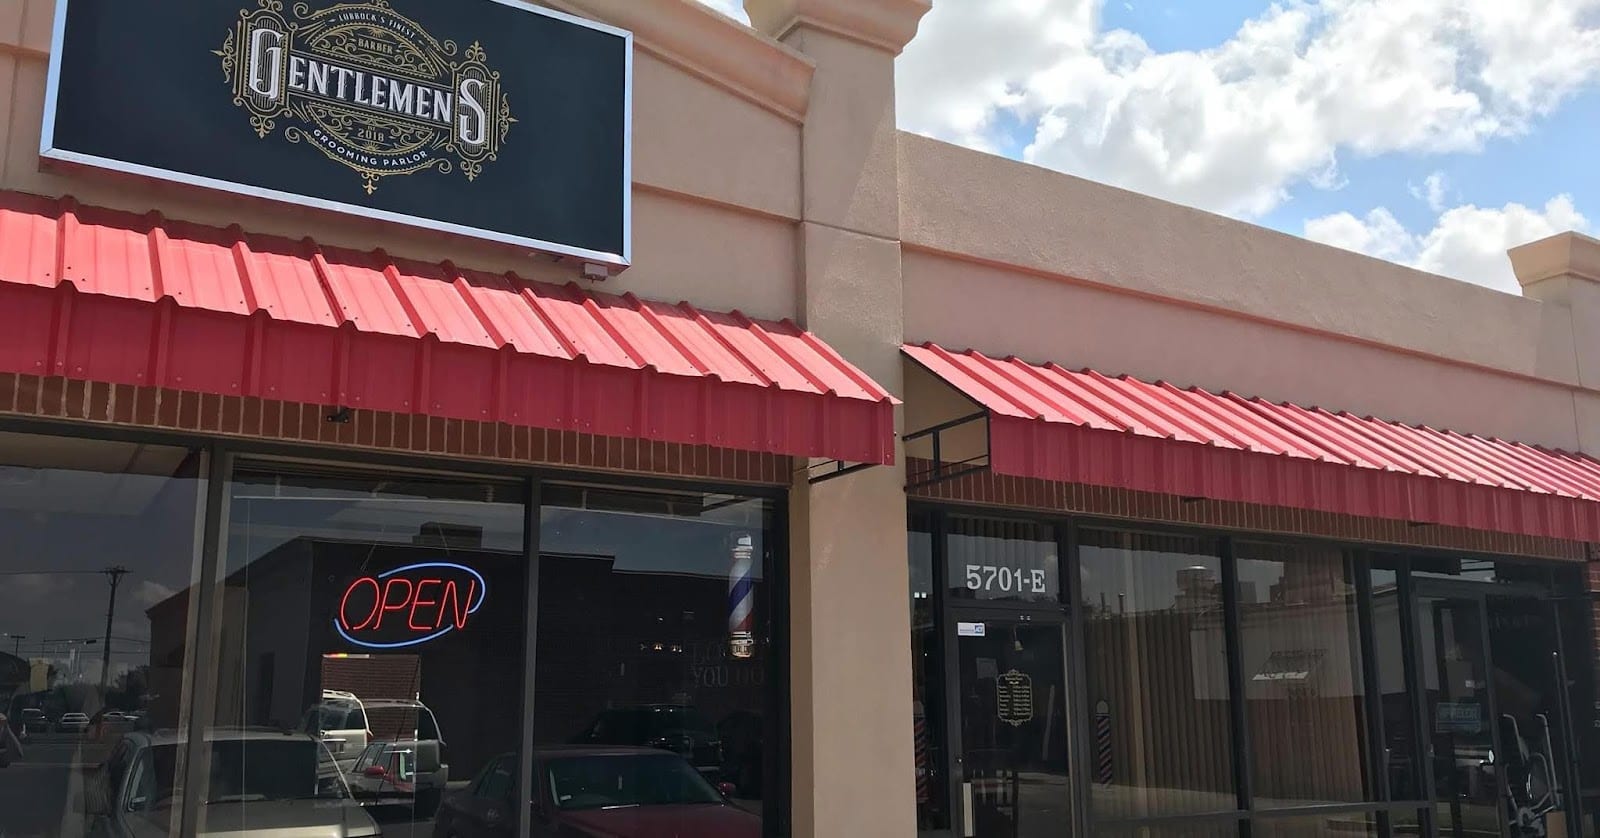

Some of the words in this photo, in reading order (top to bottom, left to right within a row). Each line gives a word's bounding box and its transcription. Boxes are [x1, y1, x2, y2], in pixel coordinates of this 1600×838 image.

[338, 12, 385, 24] LUBBOCK'S
[389, 19, 416, 39] FINEST
[358, 38, 393, 54] BARBER
[249, 28, 486, 145] GENTLEMENS
[313, 129, 378, 165] GROOMING
[383, 150, 428, 166] PARLOR
[357, 128, 384, 142] 2018
[966, 564, 1046, 593] 5701-E
[340, 577, 475, 630] OPEN
